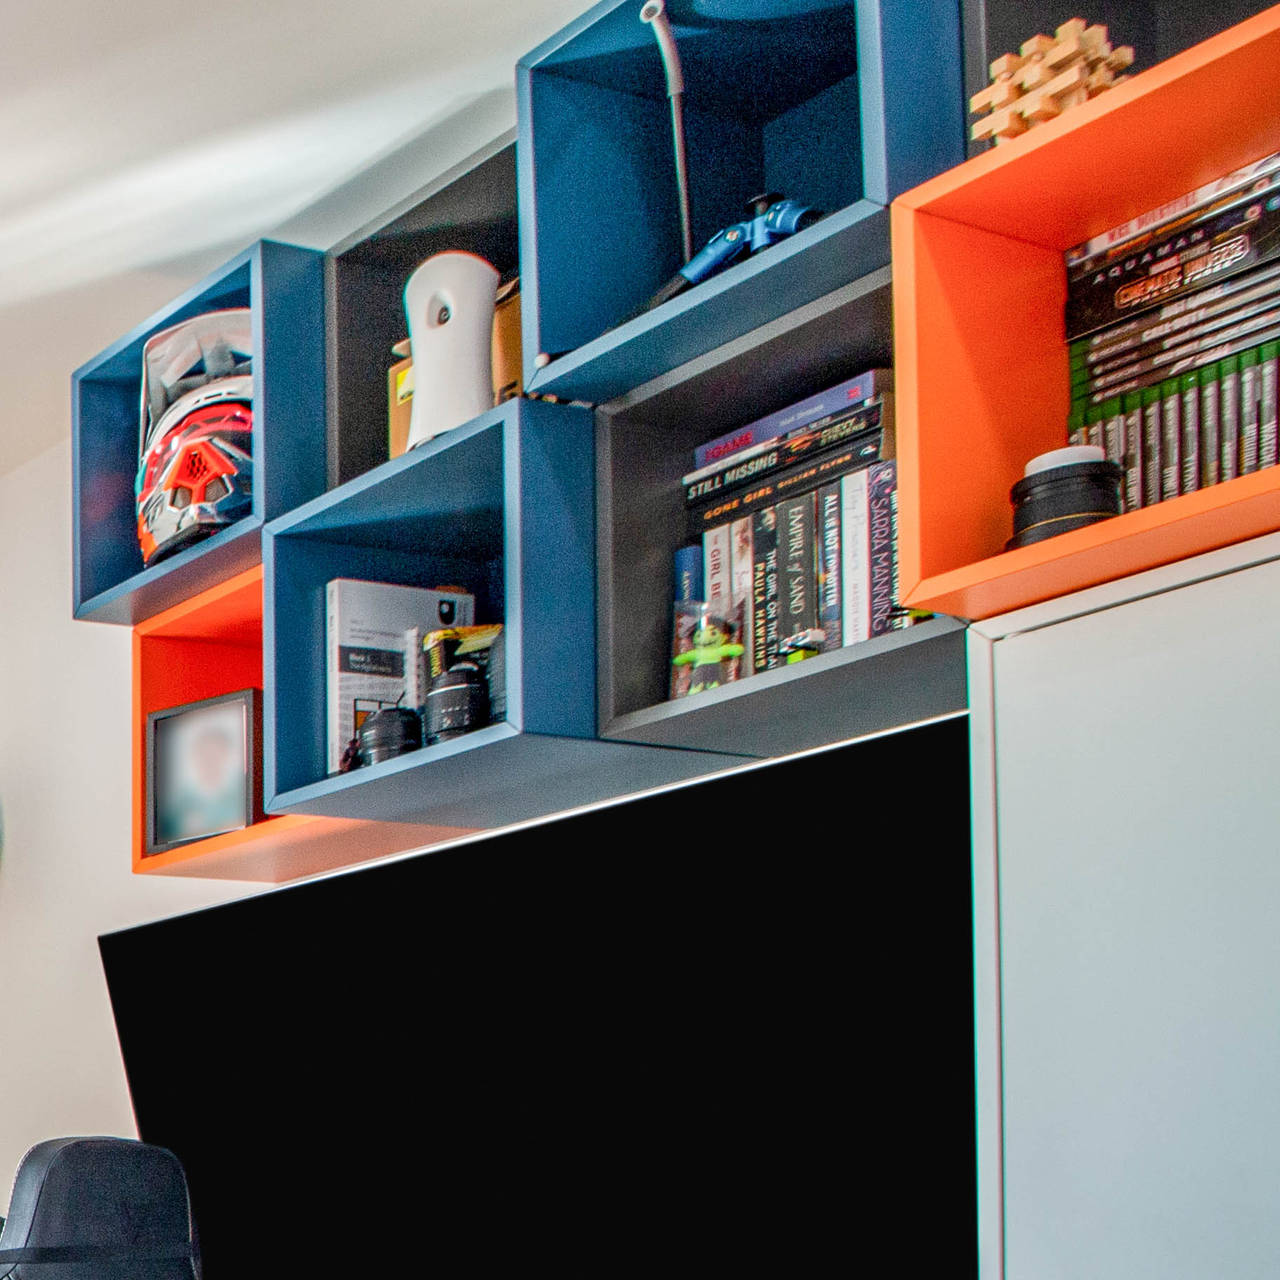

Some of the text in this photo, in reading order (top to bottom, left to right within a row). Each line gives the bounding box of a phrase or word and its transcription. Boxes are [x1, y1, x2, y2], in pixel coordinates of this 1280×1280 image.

[1092, 230, 1205, 285] AQUAMAN
[688, 476, 722, 500] STILL
[724, 452, 779, 486] MISSING
[704, 485, 774, 520] GONE GIRL
[824, 493, 839, 517] ALL
[789, 505, 805, 561] EMPIRE
[824, 527, 839, 552] NOT
[710, 548, 721, 581] GIRL
[766, 548, 777, 572] THE
[871, 496, 892, 632] SARRA MANNING
[766, 573, 777, 600] GIRL
[789, 575, 805, 615] SAND
[755, 562, 767, 669] PAULA HAWKINS
[766, 602, 777, 618] ON
[766, 620, 777, 641] THE
